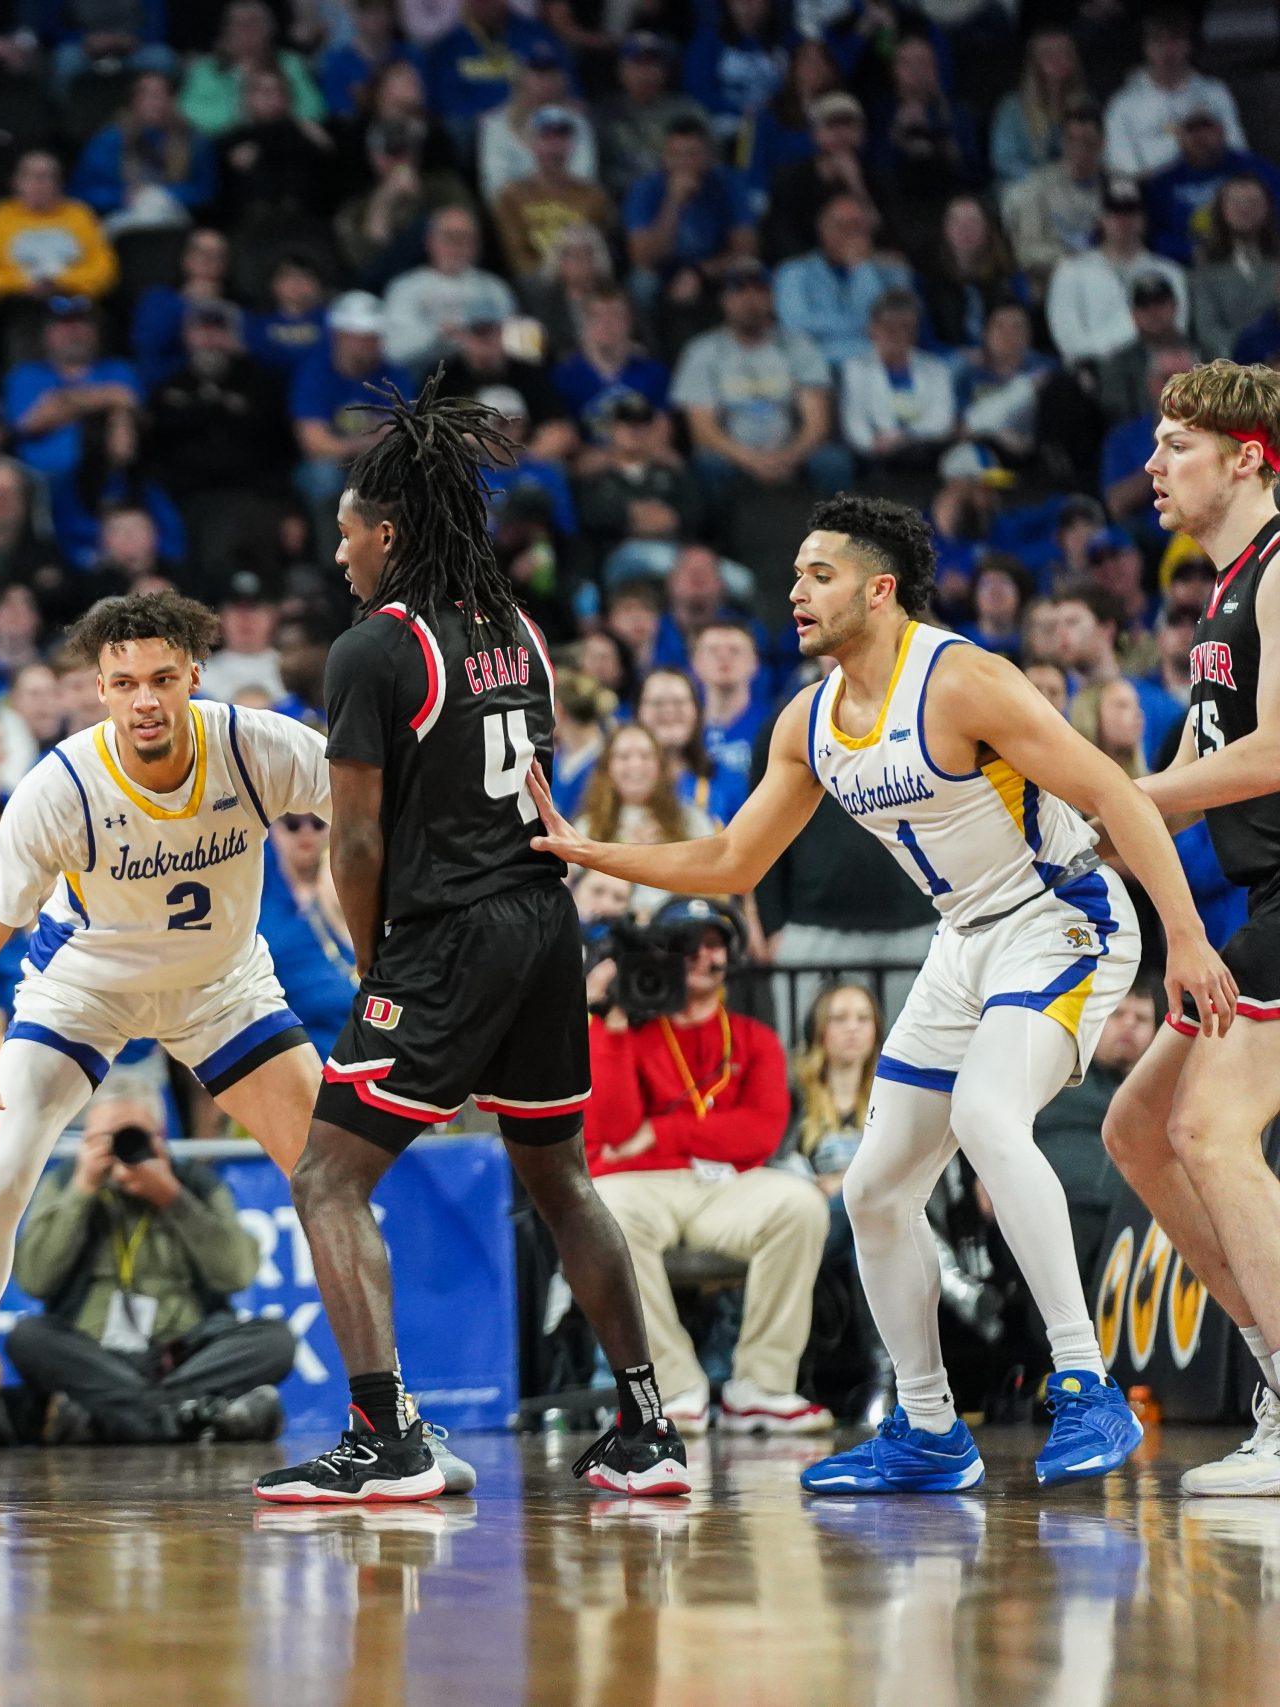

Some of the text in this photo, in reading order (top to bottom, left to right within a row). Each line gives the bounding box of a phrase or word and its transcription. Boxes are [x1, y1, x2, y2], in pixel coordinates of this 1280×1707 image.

[464, 645, 530, 696] CRAIG
[1189, 640, 1238, 692] ENVER
[483, 708, 540, 825] 4
[830, 764, 935, 817] Jackrabbits
[110, 827, 248, 881] Jackrabbits
[896, 819, 954, 897] 1
[165, 880, 212, 931] 2
[363, 995, 404, 1031] DU
